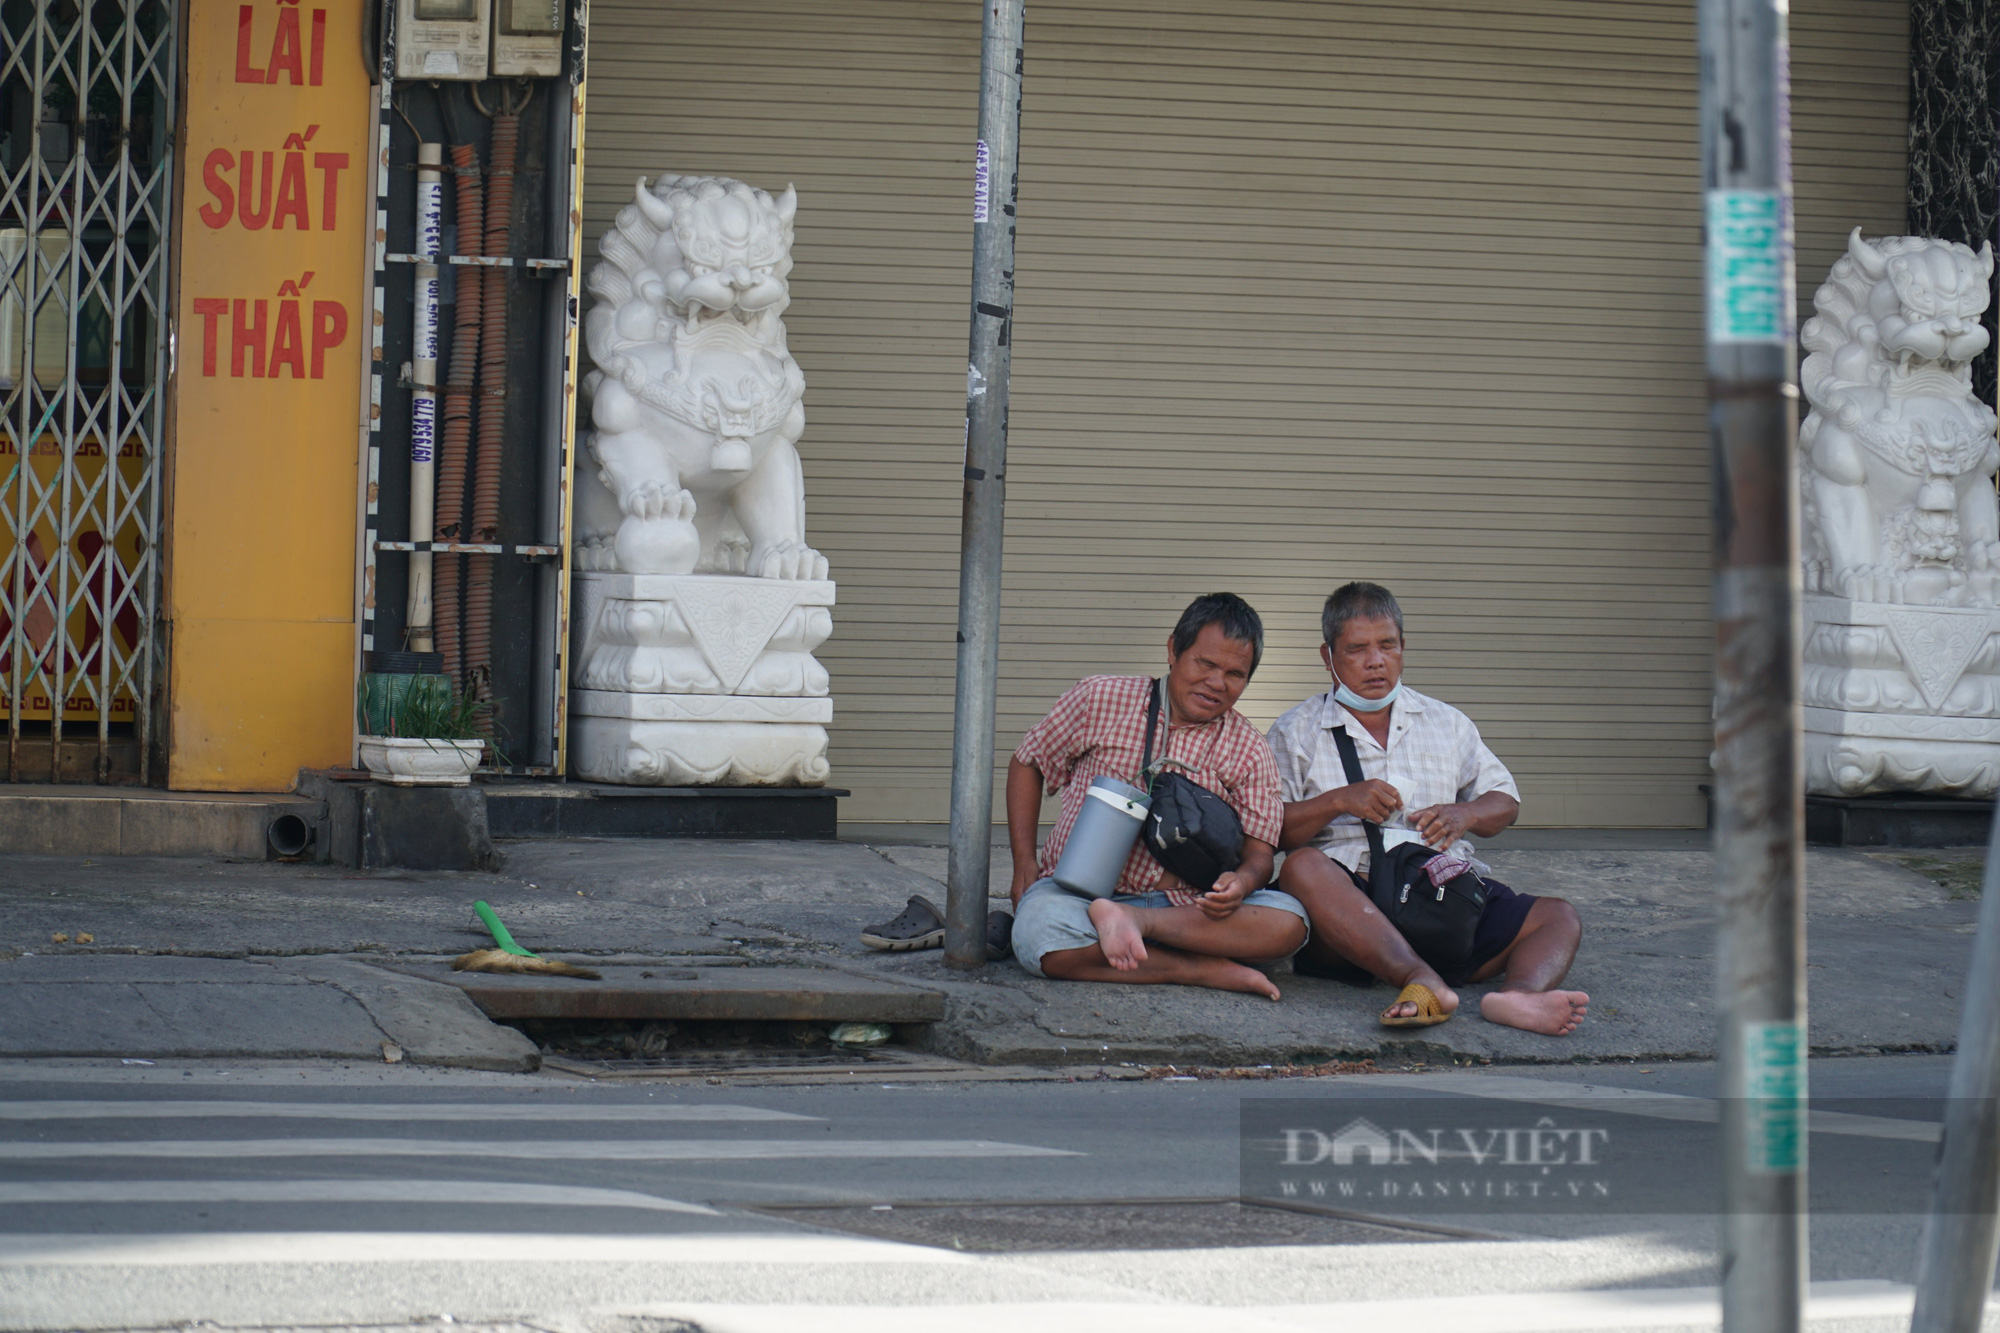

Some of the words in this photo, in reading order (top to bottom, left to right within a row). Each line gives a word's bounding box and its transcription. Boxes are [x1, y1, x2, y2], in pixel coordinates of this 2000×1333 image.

[235, 0, 326, 87] LÃI
[199, 124, 349, 231] SUẤT
[193, 271, 348, 380] THẤP
[412, 398, 434, 462] 0979.534.779
